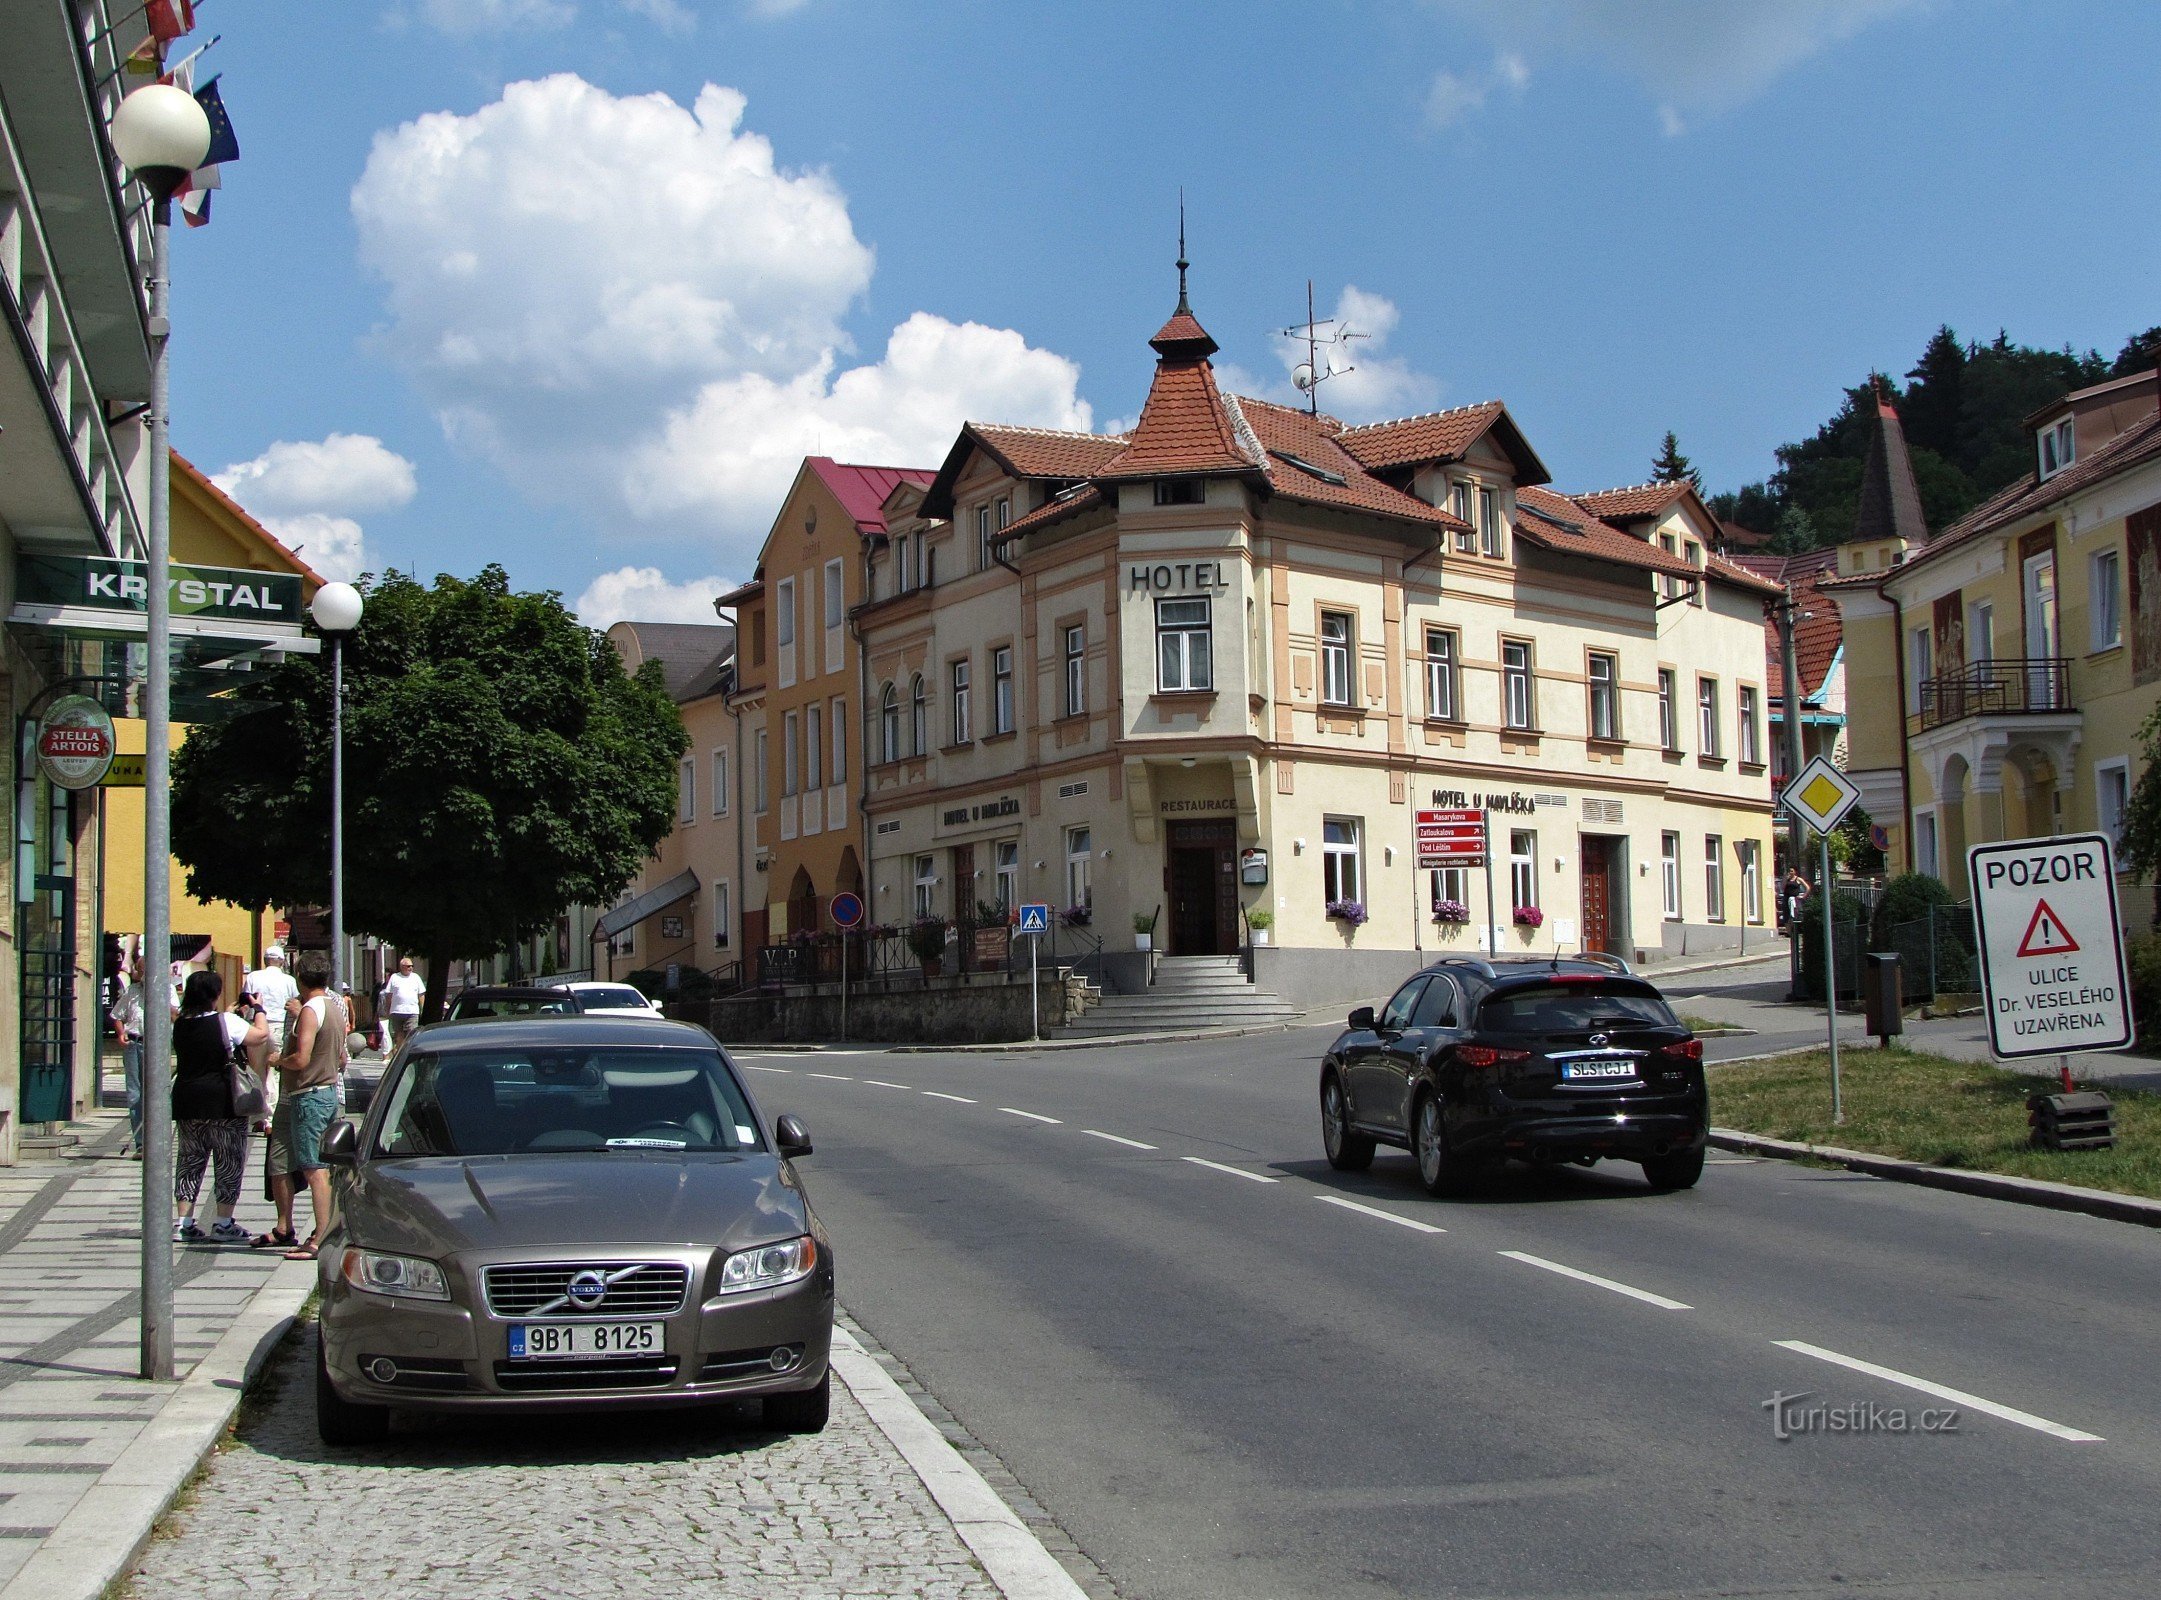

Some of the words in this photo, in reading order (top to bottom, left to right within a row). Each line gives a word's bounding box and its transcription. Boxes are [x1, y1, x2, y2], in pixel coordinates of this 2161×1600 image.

[1131, 562, 1230, 591] HOTEL
[89, 572, 283, 611] KRSTAL
[51, 730, 100, 741] STELLA
[50, 741, 100, 752] ARTOIS
[112, 765, 143, 776] UNA
[1161, 799, 1237, 812] RESTAURACE
[1432, 789, 1469, 808] HOTEL
[1472, 792, 1482, 809] U
[1433, 812, 1466, 822] Masarykova
[1420, 828, 1454, 837] Zatloukalova
[1421, 843, 1432, 852] Pod
[1986, 852, 2095, 889] POZOR
[2029, 966, 2080, 986] ULICE
[1999, 997, 2022, 1014] Dr.
[2025, 986, 2115, 1010] VESELÉHO
[2014, 1012, 2105, 1035] UZAVŘENA
[1573, 1063, 1598, 1076] SLS
[530, 1327, 574, 1352] 9B1
[594, 1325, 654, 1350] 8125
[512, 1344, 524, 1352] CZ
